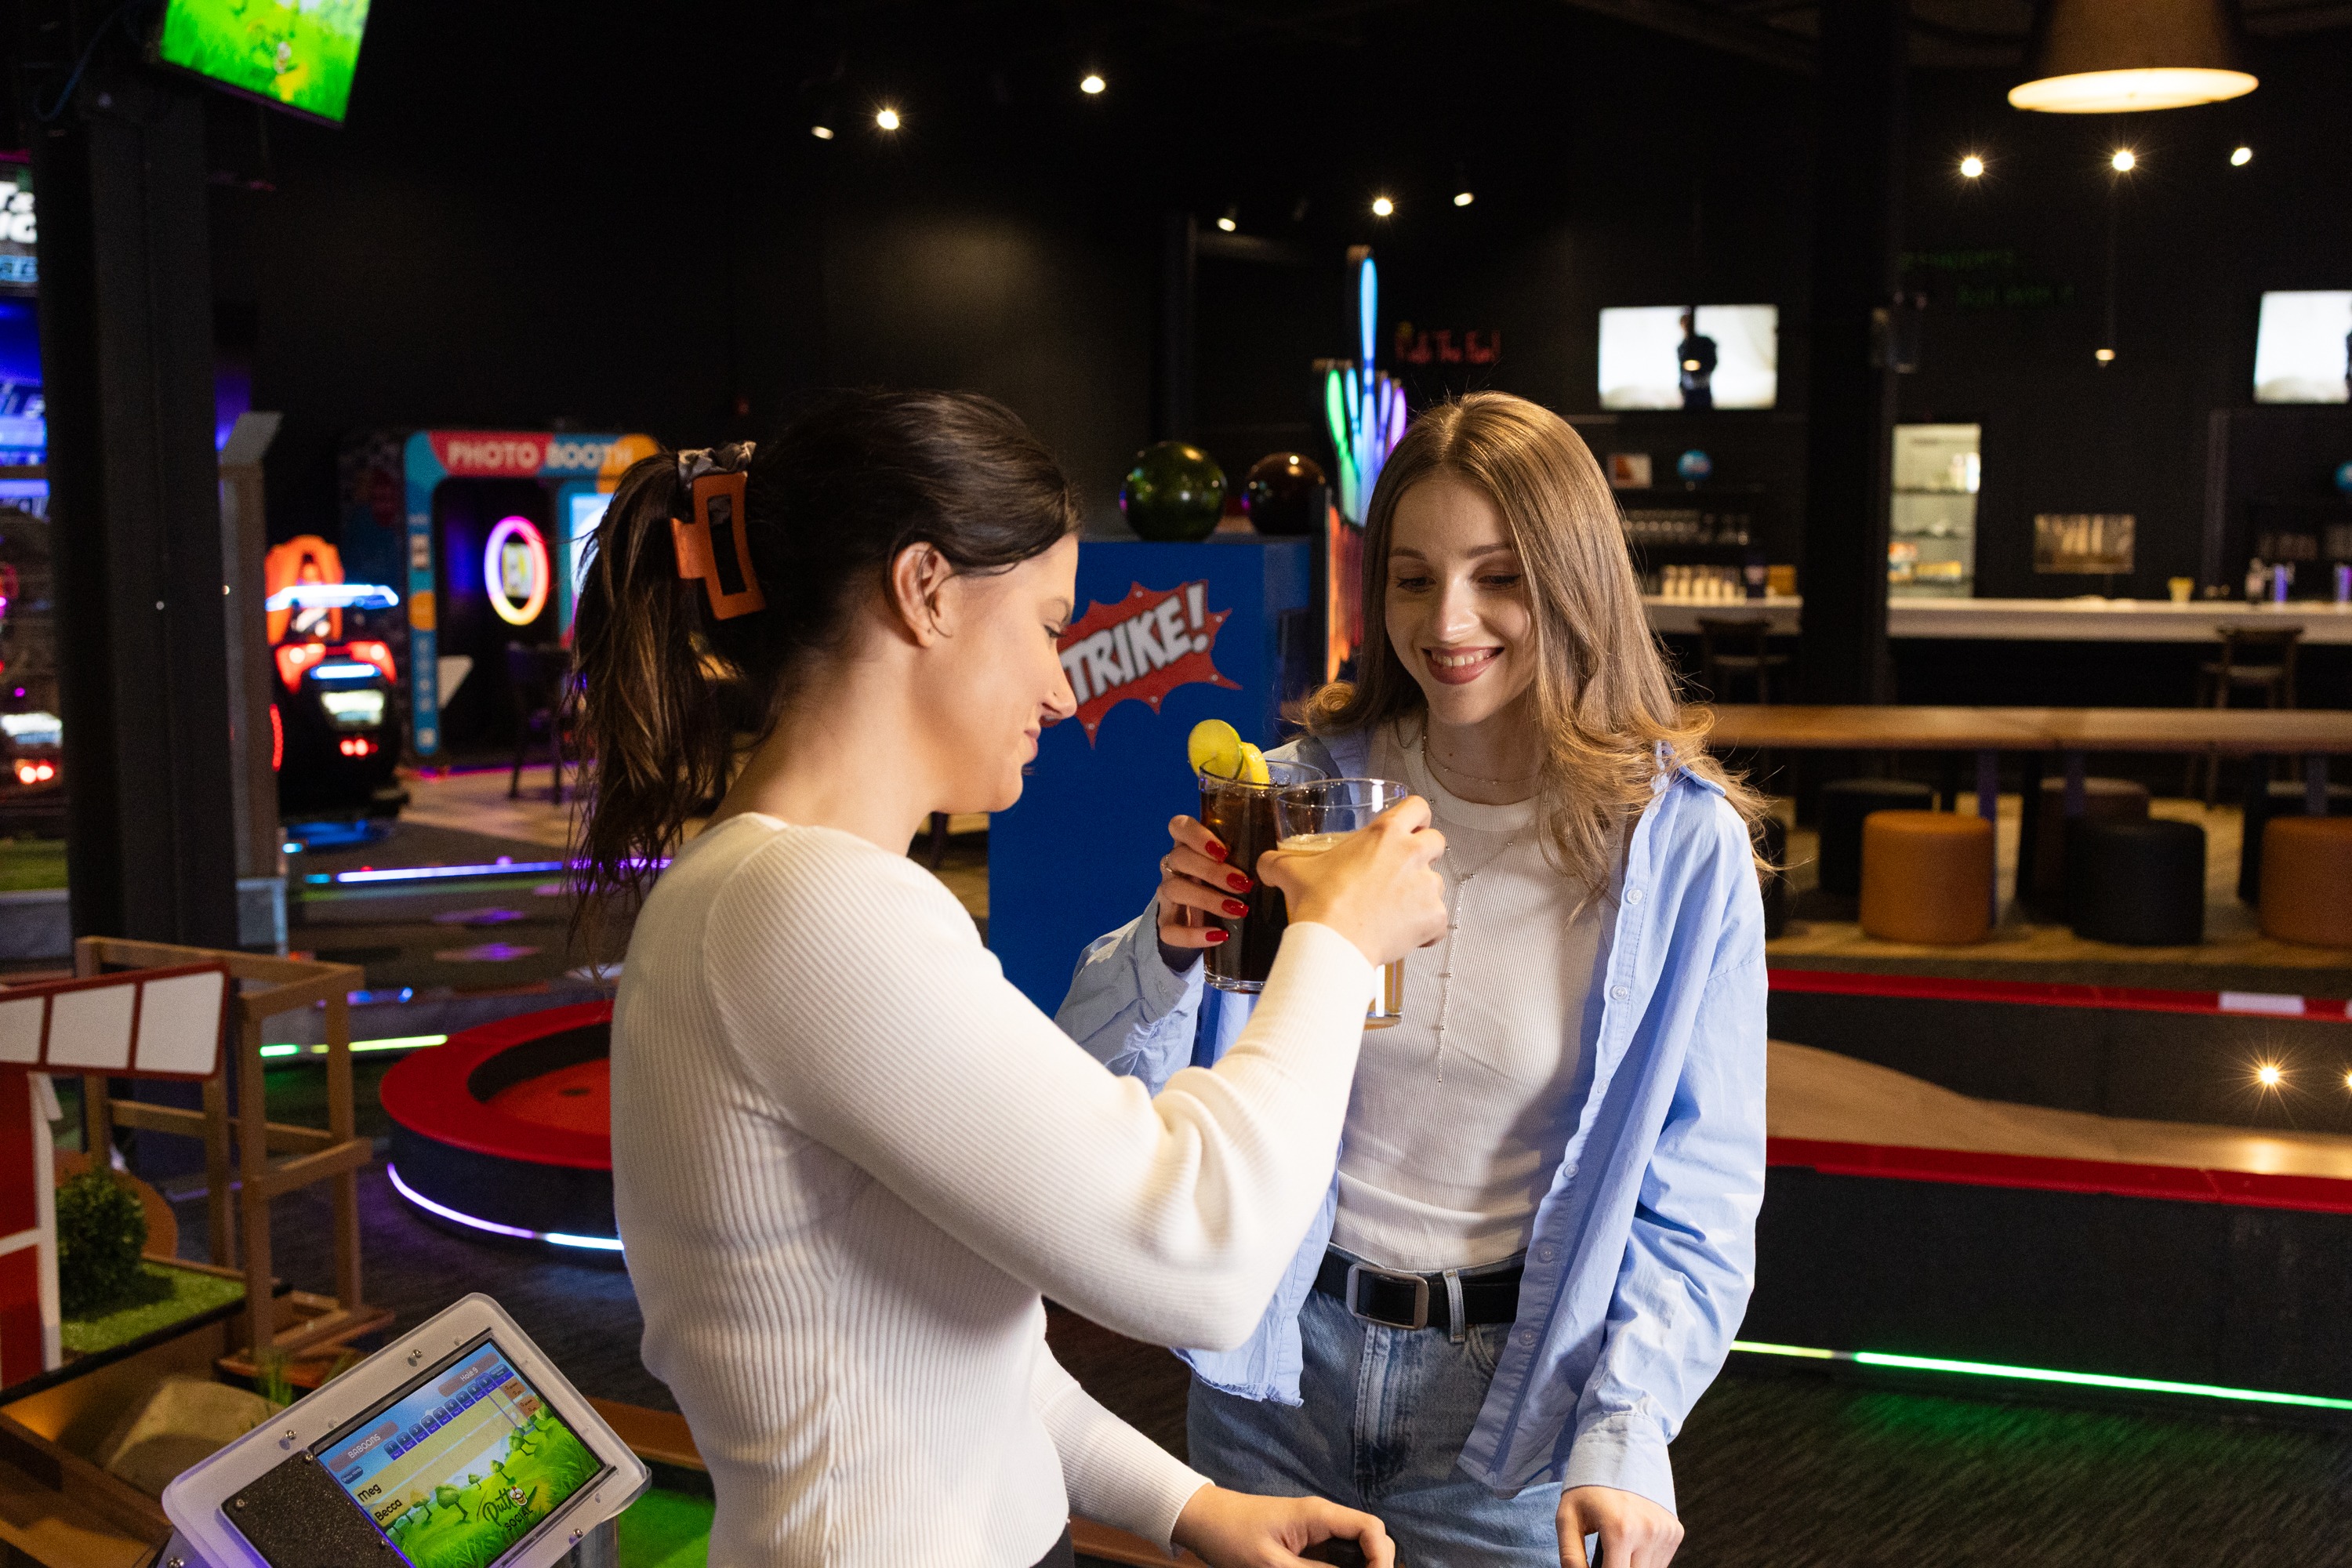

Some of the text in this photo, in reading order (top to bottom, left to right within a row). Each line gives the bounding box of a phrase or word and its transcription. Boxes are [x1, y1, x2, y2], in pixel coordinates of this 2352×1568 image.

[447, 440, 633, 469] PHOTO BOOTH
[1058, 583, 1209, 706] TRIKE!
[459, 1370, 474, 1382] Hole
[357, 1483, 382, 1503] Meg
[374, 1498, 403, 1522] Becca
[482, 1487, 517, 1527] Putt
[504, 1506, 533, 1531] SOCIAL
